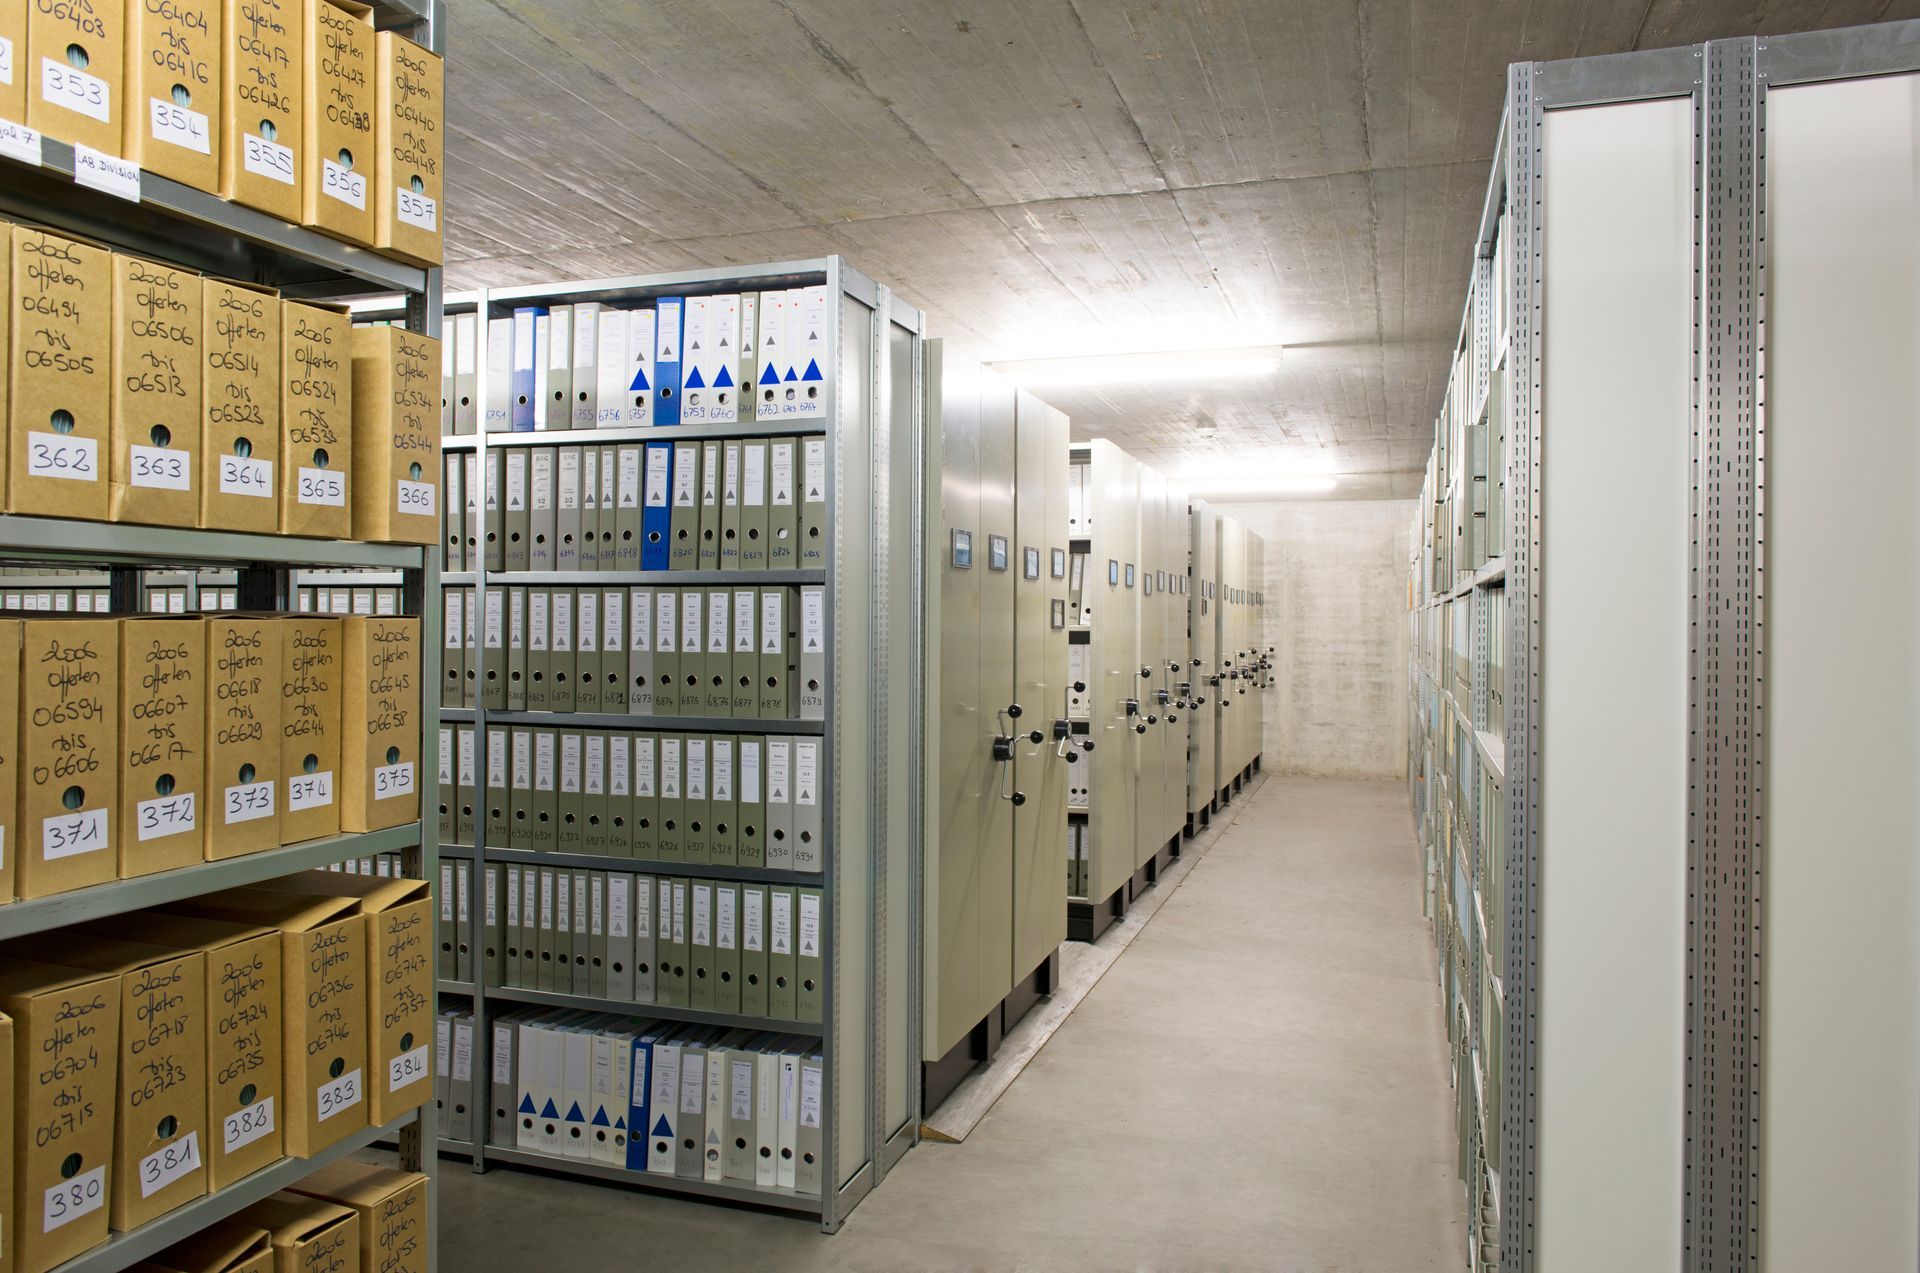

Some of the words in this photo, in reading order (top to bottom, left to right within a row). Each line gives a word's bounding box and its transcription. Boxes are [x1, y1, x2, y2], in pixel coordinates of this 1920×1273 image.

[38, 0, 105, 38] 06403
[145, 0, 208, 37] 06404
[319, 5, 355, 36] 2006
[239, 35, 289, 69] 06417
[396, 48, 428, 76] 2006
[152, 49, 209, 84] 06416
[322, 58, 365, 88] 06427
[49, 68, 102, 105] 353
[239, 84, 290, 114] 06426
[156, 105, 201, 139] 354
[395, 103, 435, 131] 06440
[77, 154, 95, 169] LAB
[249, 140, 292, 174] 355
[394, 147, 435, 175] 06448
[326, 167, 361, 198] 356
[401, 194, 434, 220] 357
[23, 231, 81, 264] 2006
[129, 261, 179, 290] 2006
[23, 296, 79, 324] 06494
[219, 289, 263, 318] 2006
[132, 320, 194, 345] 06506
[294, 319, 332, 345] 2006
[398, 335, 429, 361] 2006
[26, 350, 94, 374] 06505
[209, 351, 259, 378] 06514
[127, 373, 186, 396] 06513
[291, 379, 336, 405] 06524
[395, 389, 433, 412] 06534
[684, 406, 705, 418] 6759
[710, 408, 734, 419] 6760
[757, 403, 779, 416] 6762
[209, 404, 264, 425] 06523
[599, 409, 620, 422] 6756
[290, 428, 337, 444] 06533
[393, 434, 432, 453] 06544
[33, 444, 90, 471] 362
[134, 455, 181, 478] 363
[224, 462, 266, 488] 364
[302, 478, 340, 498] 365
[401, 488, 429, 506] 366
[225, 629, 262, 648] 2006
[293, 628, 328, 648] 2006
[373, 623, 410, 643] 2006
[41, 640, 98, 662] 2006
[145, 640, 189, 663] 2006
[217, 678, 262, 699] 06618
[283, 676, 329, 698] 06630
[370, 674, 410, 694] 06645
[33, 696, 103, 727] 06594
[133, 694, 189, 720] 06607
[631, 694, 652, 704] 6873
[802, 696, 822, 706] 6879
[218, 722, 263, 745] 06629
[284, 719, 325, 737] 06644
[367, 711, 408, 735] 06658
[33, 747, 99, 785] 06606
[292, 779, 327, 800] 374
[377, 768, 410, 792] 375
[143, 797, 193, 829] 372
[229, 787, 270, 814] 373
[49, 818, 98, 849] 371
[768, 847, 788, 858] 6930
[387, 912, 421, 935] 2006
[310, 926, 347, 953] 2006
[132, 964, 182, 997] 2006
[221, 953, 263, 985] 2006
[385, 954, 427, 984] 06747
[308, 975, 354, 1009] 06736
[55, 995, 106, 1024] 2006
[219, 1003, 268, 1035] 06724
[384, 993, 427, 1030] 06757
[307, 1022, 350, 1056] 06746
[40, 1046, 98, 1085] 06704
[217, 1050, 265, 1085] 06735
[393, 1055, 422, 1082] 384
[130, 1066, 187, 1107] 06723
[320, 1080, 355, 1115] 383
[36, 1102, 94, 1147] 06715
[227, 1103, 267, 1144] 382
[145, 1139, 191, 1184] 381
[50, 1178, 100, 1218] 380
[305, 1230, 346, 1267] 2006
